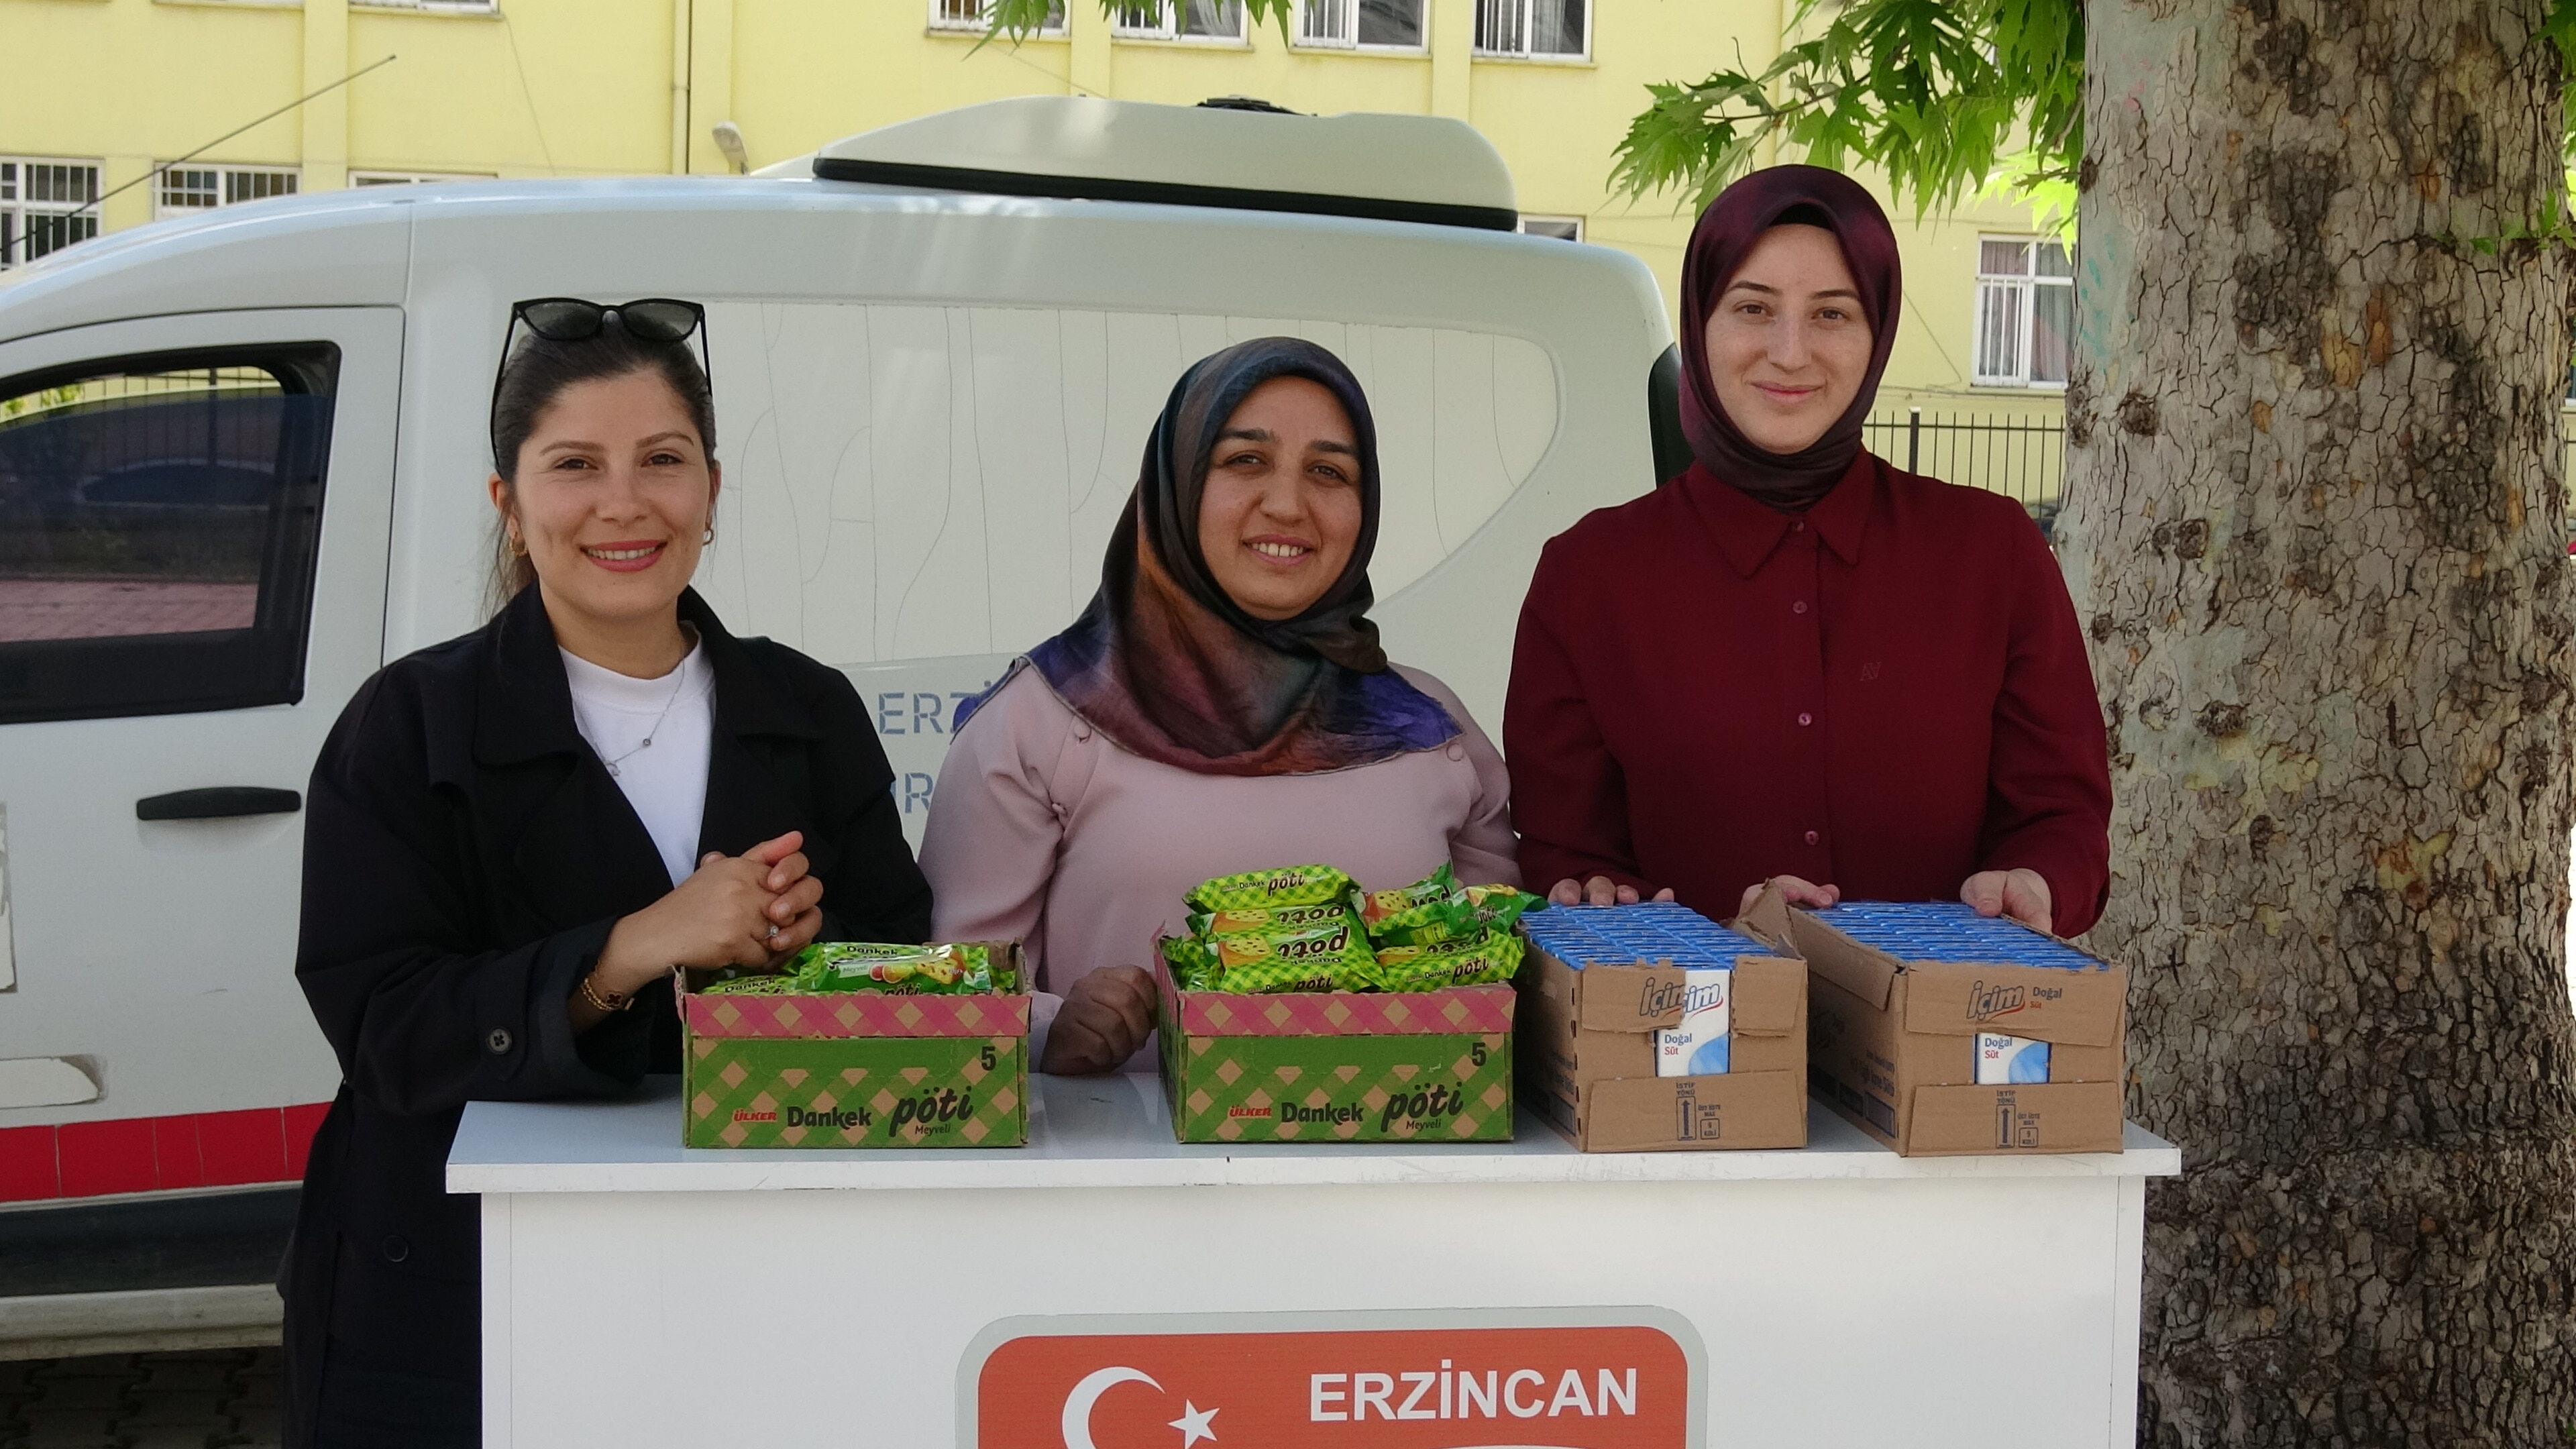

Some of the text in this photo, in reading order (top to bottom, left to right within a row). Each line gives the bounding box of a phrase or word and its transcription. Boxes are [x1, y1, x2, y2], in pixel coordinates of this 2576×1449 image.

[879, 680, 991, 735] ER
[890, 772, 933, 813] R
[1268, 872, 1305, 896] pöti
[847, 946, 898, 955] Dankek
[1277, 926, 1349, 960] pöti
[1452, 955, 1489, 984] pöti
[724, 979, 776, 993] Dankek
[1293, 973, 1333, 993] pöti
[1966, 980, 2062, 1021] İçim Doğal
[2030, 1001, 2042, 1009] Süt
[1664, 1046, 1679, 1055] Süt
[1665, 1033, 1693, 1046] Doğal
[1985, 1037, 2012, 1050] Doğal
[981, 1046, 996, 1071] 5
[1471, 1042, 1487, 1067] 5
[1985, 1051, 1999, 1059] Süt
[734, 1085, 973, 1138] ÜLKER Dankek pöti
[1229, 1081, 1464, 1132] ÜLKER Dankek pöti
[915, 1124, 951, 1136] Meyveli
[1406, 1120, 1442, 1132] Meyveli
[1310, 1358, 1638, 1422] ERZİNCAN
